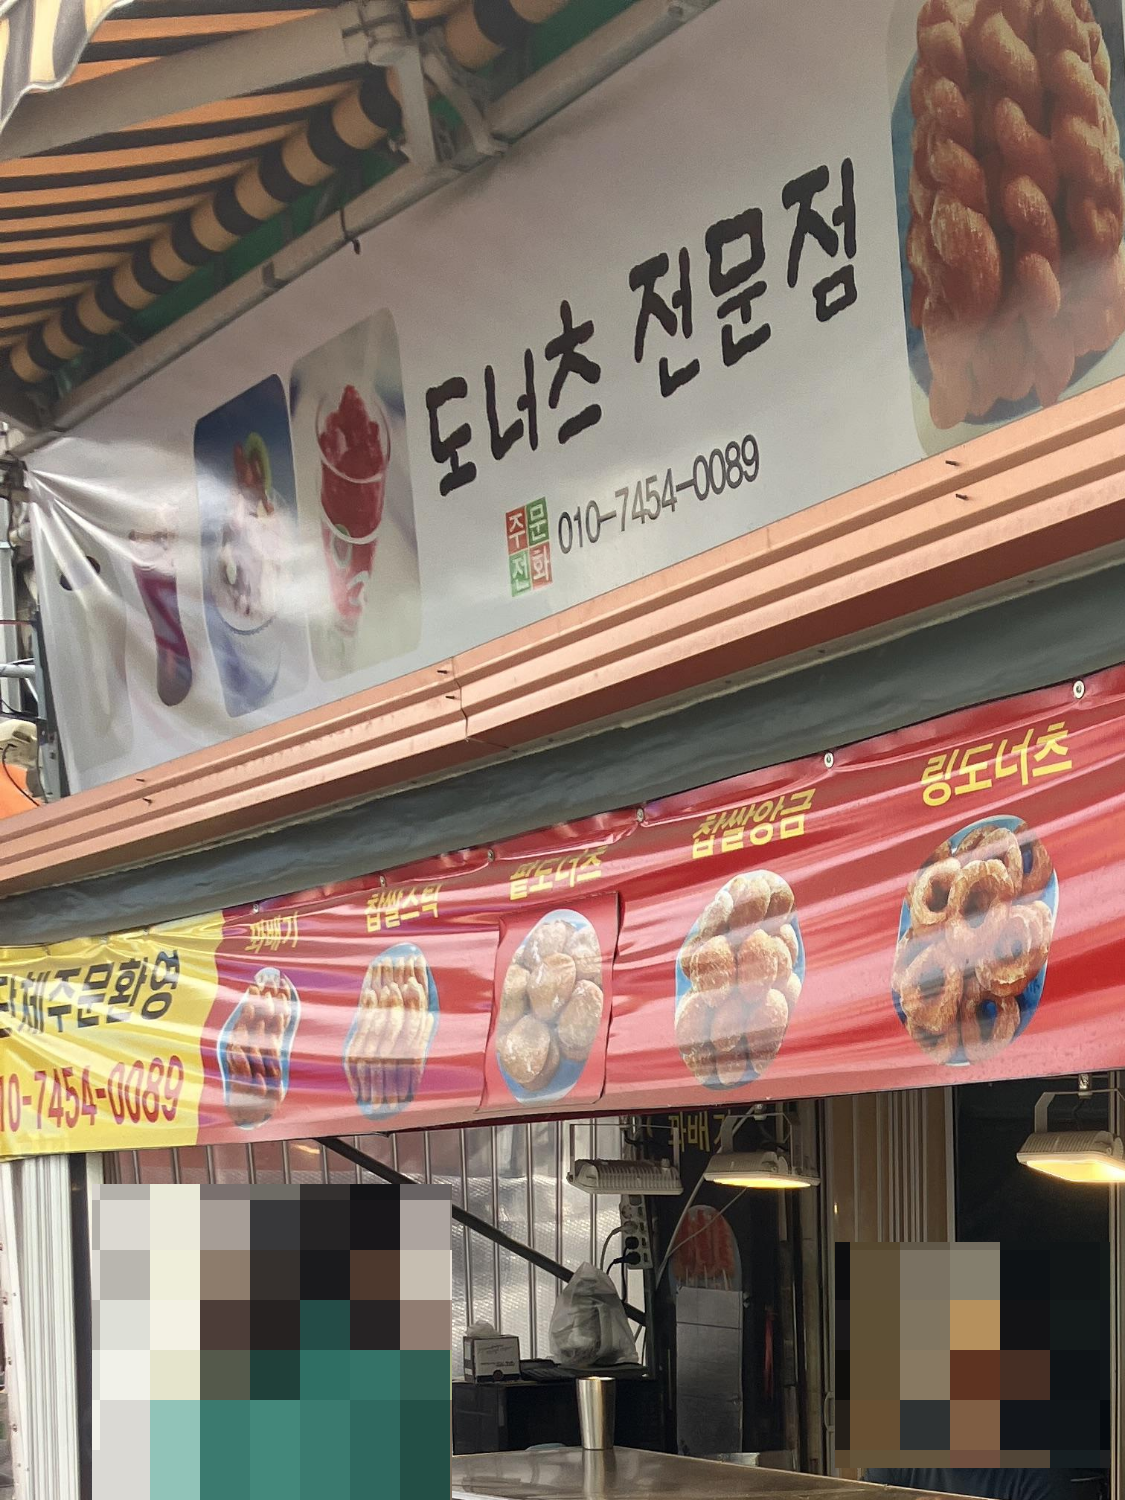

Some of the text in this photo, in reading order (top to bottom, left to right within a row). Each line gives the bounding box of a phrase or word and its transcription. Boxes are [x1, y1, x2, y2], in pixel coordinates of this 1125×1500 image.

[426, 157, 857, 496] 도너츠 전문점
[558, 434, 760, 554] 010-7454-0089
[508, 498, 548, 551] 주문
[510, 545, 552, 596] 전화
[920, 722, 1073, 806] 링도너츠
[692, 788, 816, 859] 찹쌀앙금
[510, 845, 607, 900] 팥도너츠
[245, 911, 299, 953] 꽈배기
[365, 884, 441, 933] 찹쌀스틱
